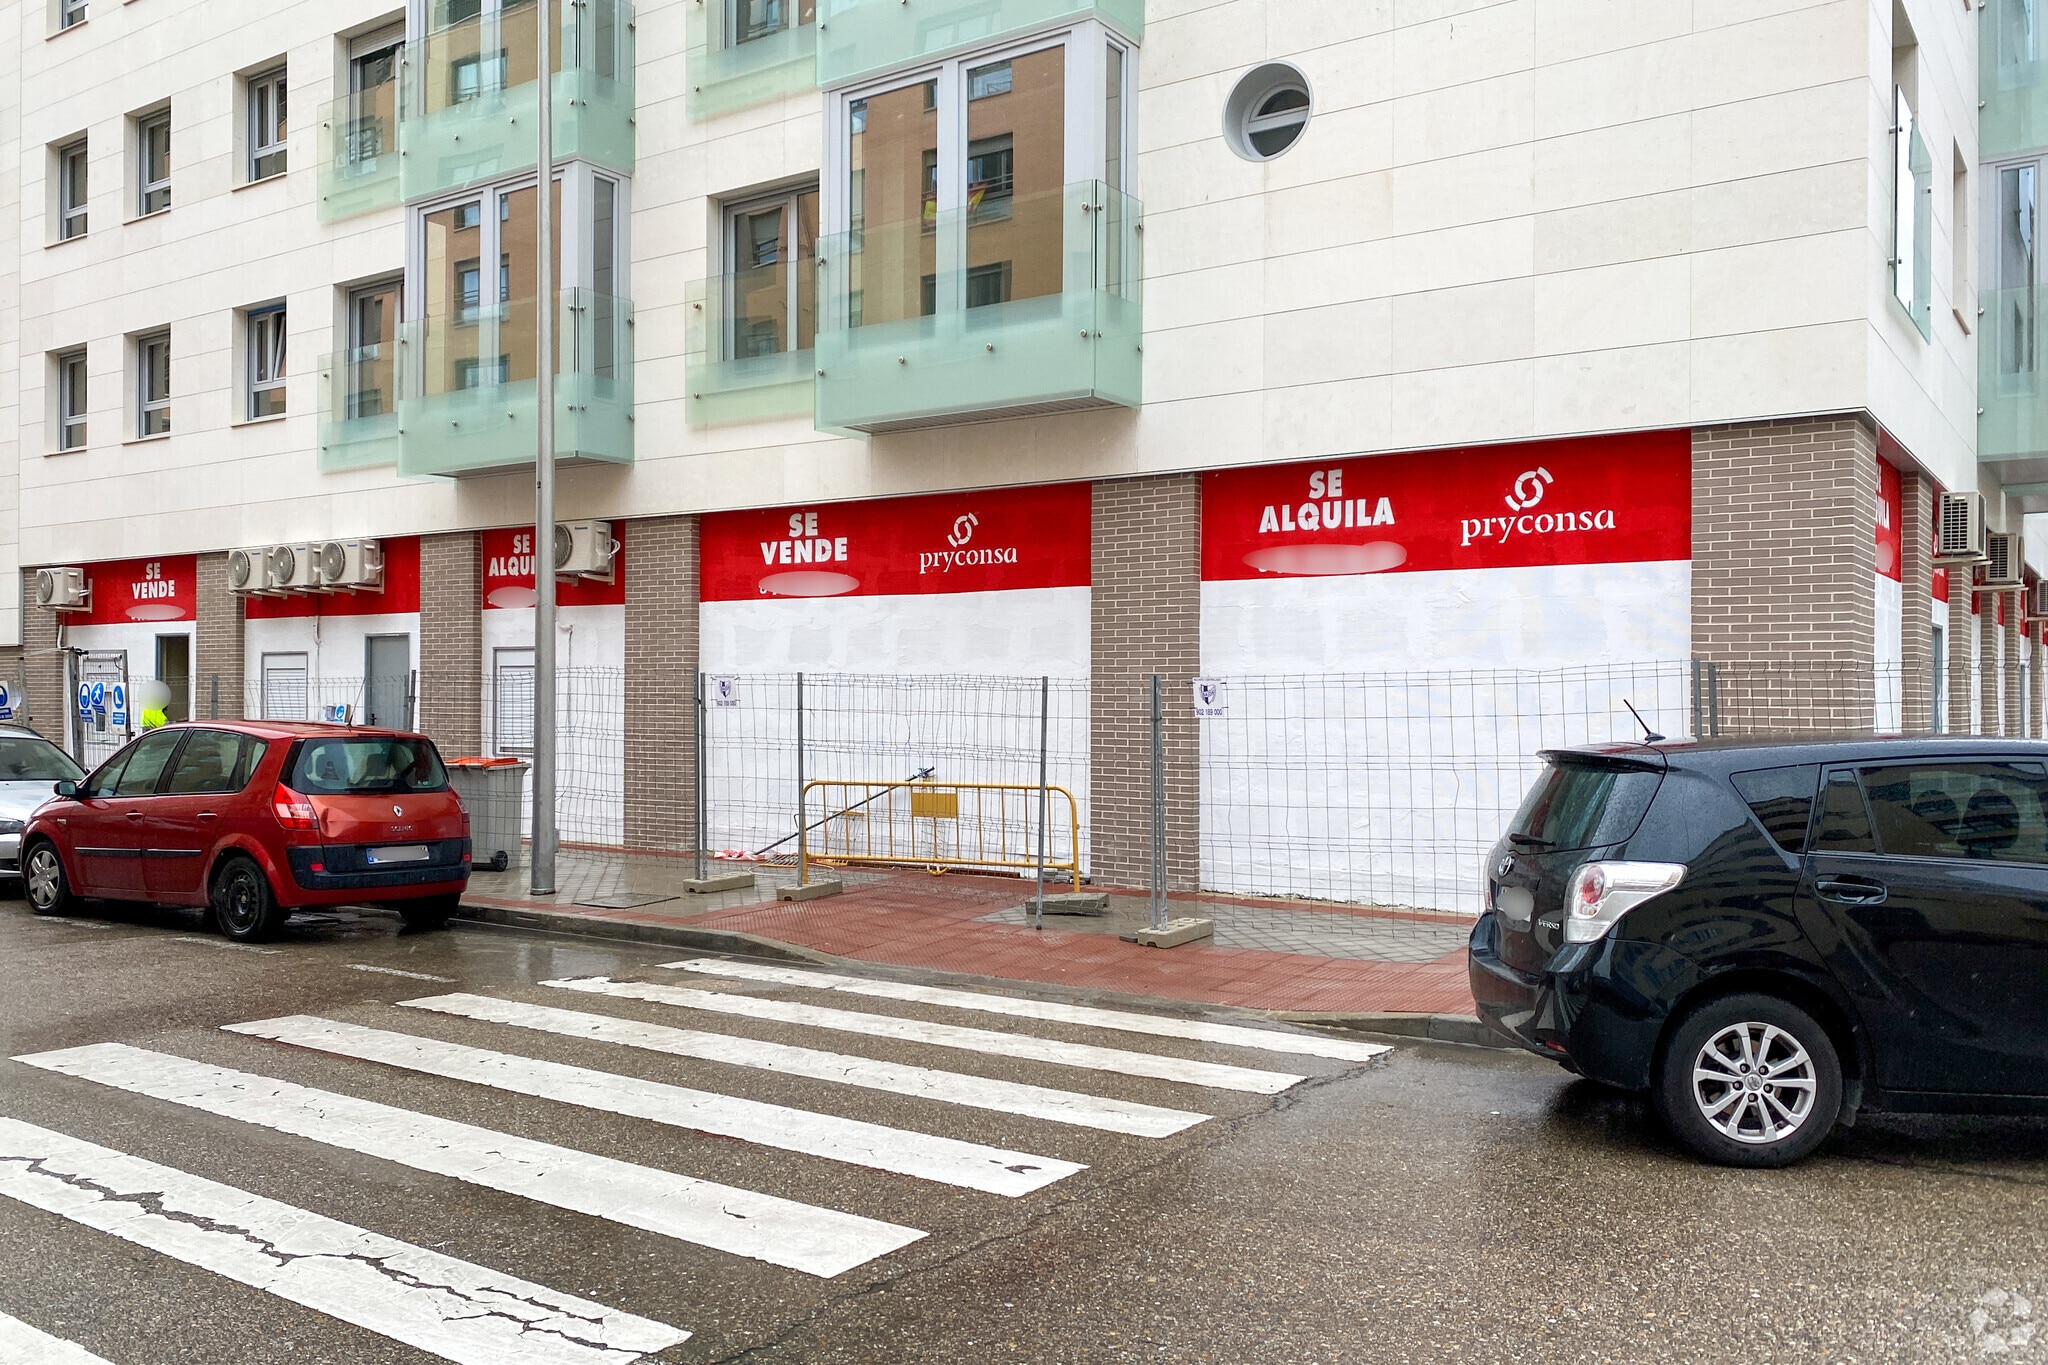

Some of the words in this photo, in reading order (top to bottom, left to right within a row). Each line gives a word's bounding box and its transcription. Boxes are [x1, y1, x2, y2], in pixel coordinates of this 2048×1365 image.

[1308, 468, 1343, 499] SE
[788, 512, 818, 537] SE
[1258, 497, 1395, 533] ALQUILA
[1460, 509, 1616, 546] pryconsa
[513, 534, 530, 554] SE
[760, 537, 848, 565] VENDE
[145, 562, 161, 580] SE
[488, 555, 535, 577] ALQUI
[919, 547, 1018, 574] pryconsa
[132, 580, 175, 600] VENDE
